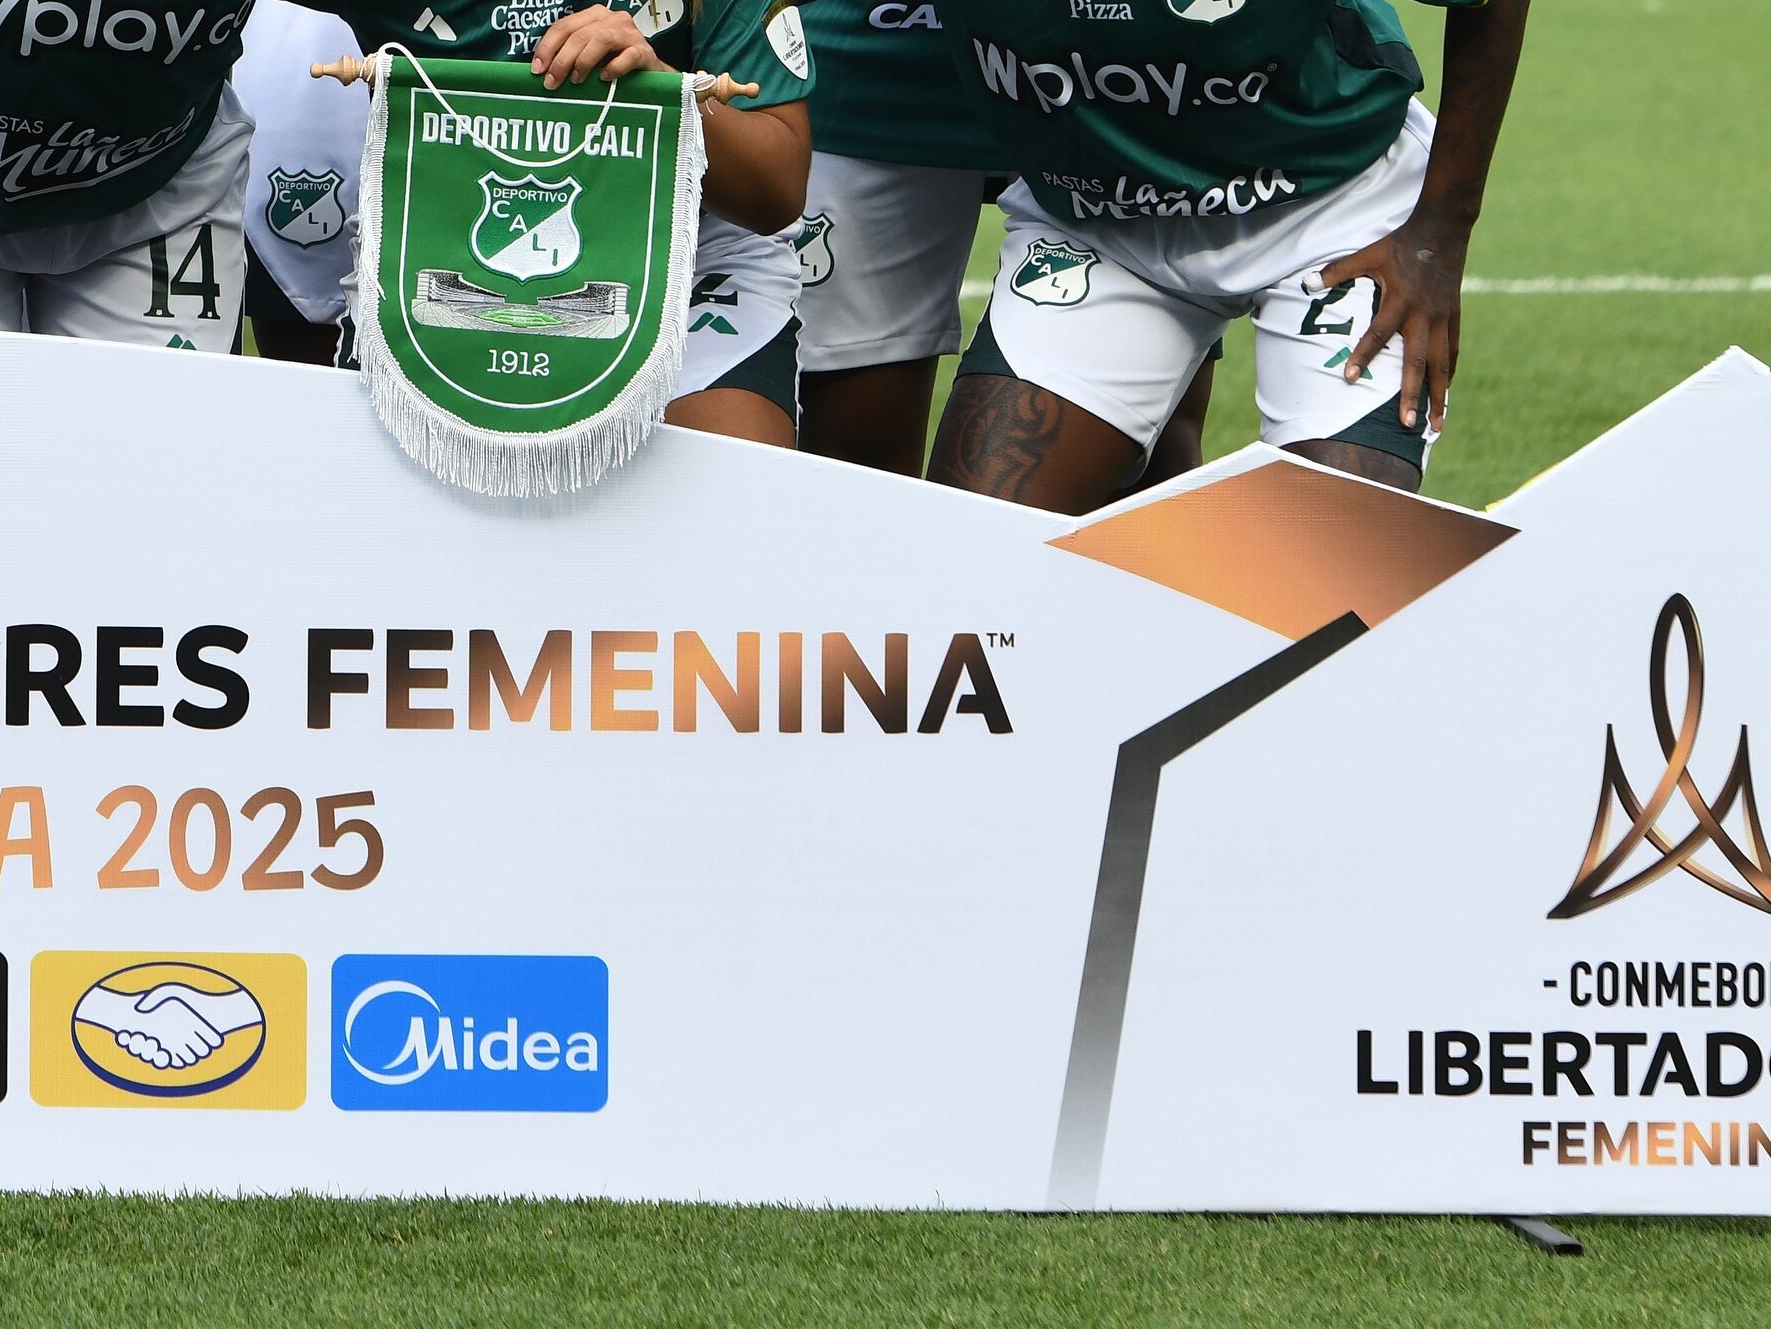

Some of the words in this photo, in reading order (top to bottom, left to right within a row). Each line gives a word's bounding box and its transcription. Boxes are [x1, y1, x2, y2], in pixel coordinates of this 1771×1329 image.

[422, 111, 571, 154] DEPORTIVO
[583, 124, 645, 159] CALI
[278, 181, 331, 192] DEPORTIVO
[492, 187, 568, 203] DEPORTIVO
[1042, 171, 1104, 193] PASTAS
[1115, 175, 1160, 205] La
[278, 190, 328, 235] CALI
[491, 201, 559, 267] CALI
[143, 222, 221, 320] 14
[789, 240, 818, 277] ALI
[1031, 255, 1068, 300] CALI
[1033, 248, 1087, 264] DEPORTIVO
[486, 349, 550, 377] 1912
[305, 627, 1015, 735] FEMENINA
[94, 784, 385, 893] 2025
[1570, 961, 1771, 1007] CONMEBO
[381, 1015, 599, 1073] Midea
[1357, 1029, 1771, 1097] LIBERTAD
